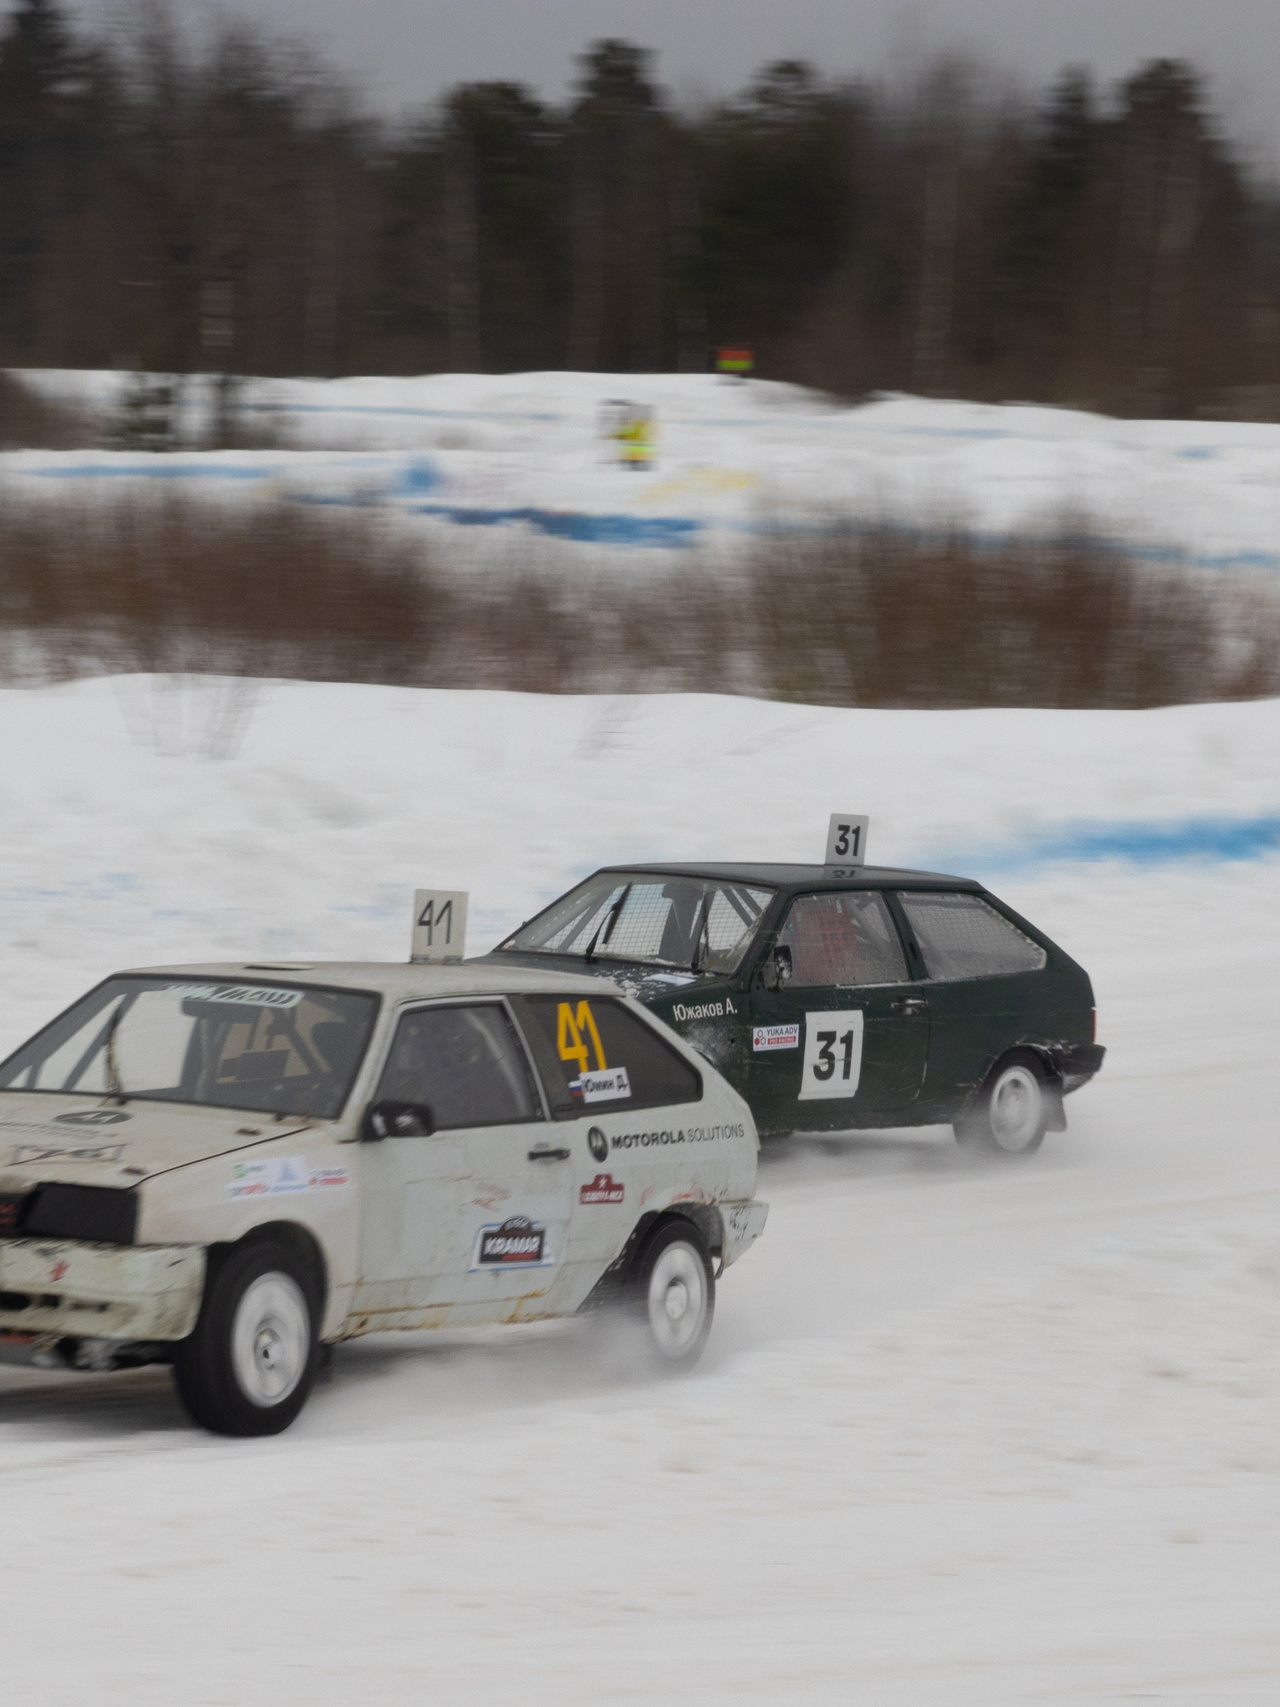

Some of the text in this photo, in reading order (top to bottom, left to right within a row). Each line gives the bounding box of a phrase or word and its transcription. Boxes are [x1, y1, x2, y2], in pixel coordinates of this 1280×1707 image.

[834, 824, 861, 857] 31
[417, 899, 452, 947] 41
[673, 998, 738, 1021] Южаков А.
[557, 1000, 607, 1074] 41
[767, 1026, 798, 1036] YUKA ADV
[812, 1029, 854, 1081] 31
[611, 1123, 745, 1149] MOTOROLA SOLUTIONS
[483, 1236, 540, 1255] KRAMAR
